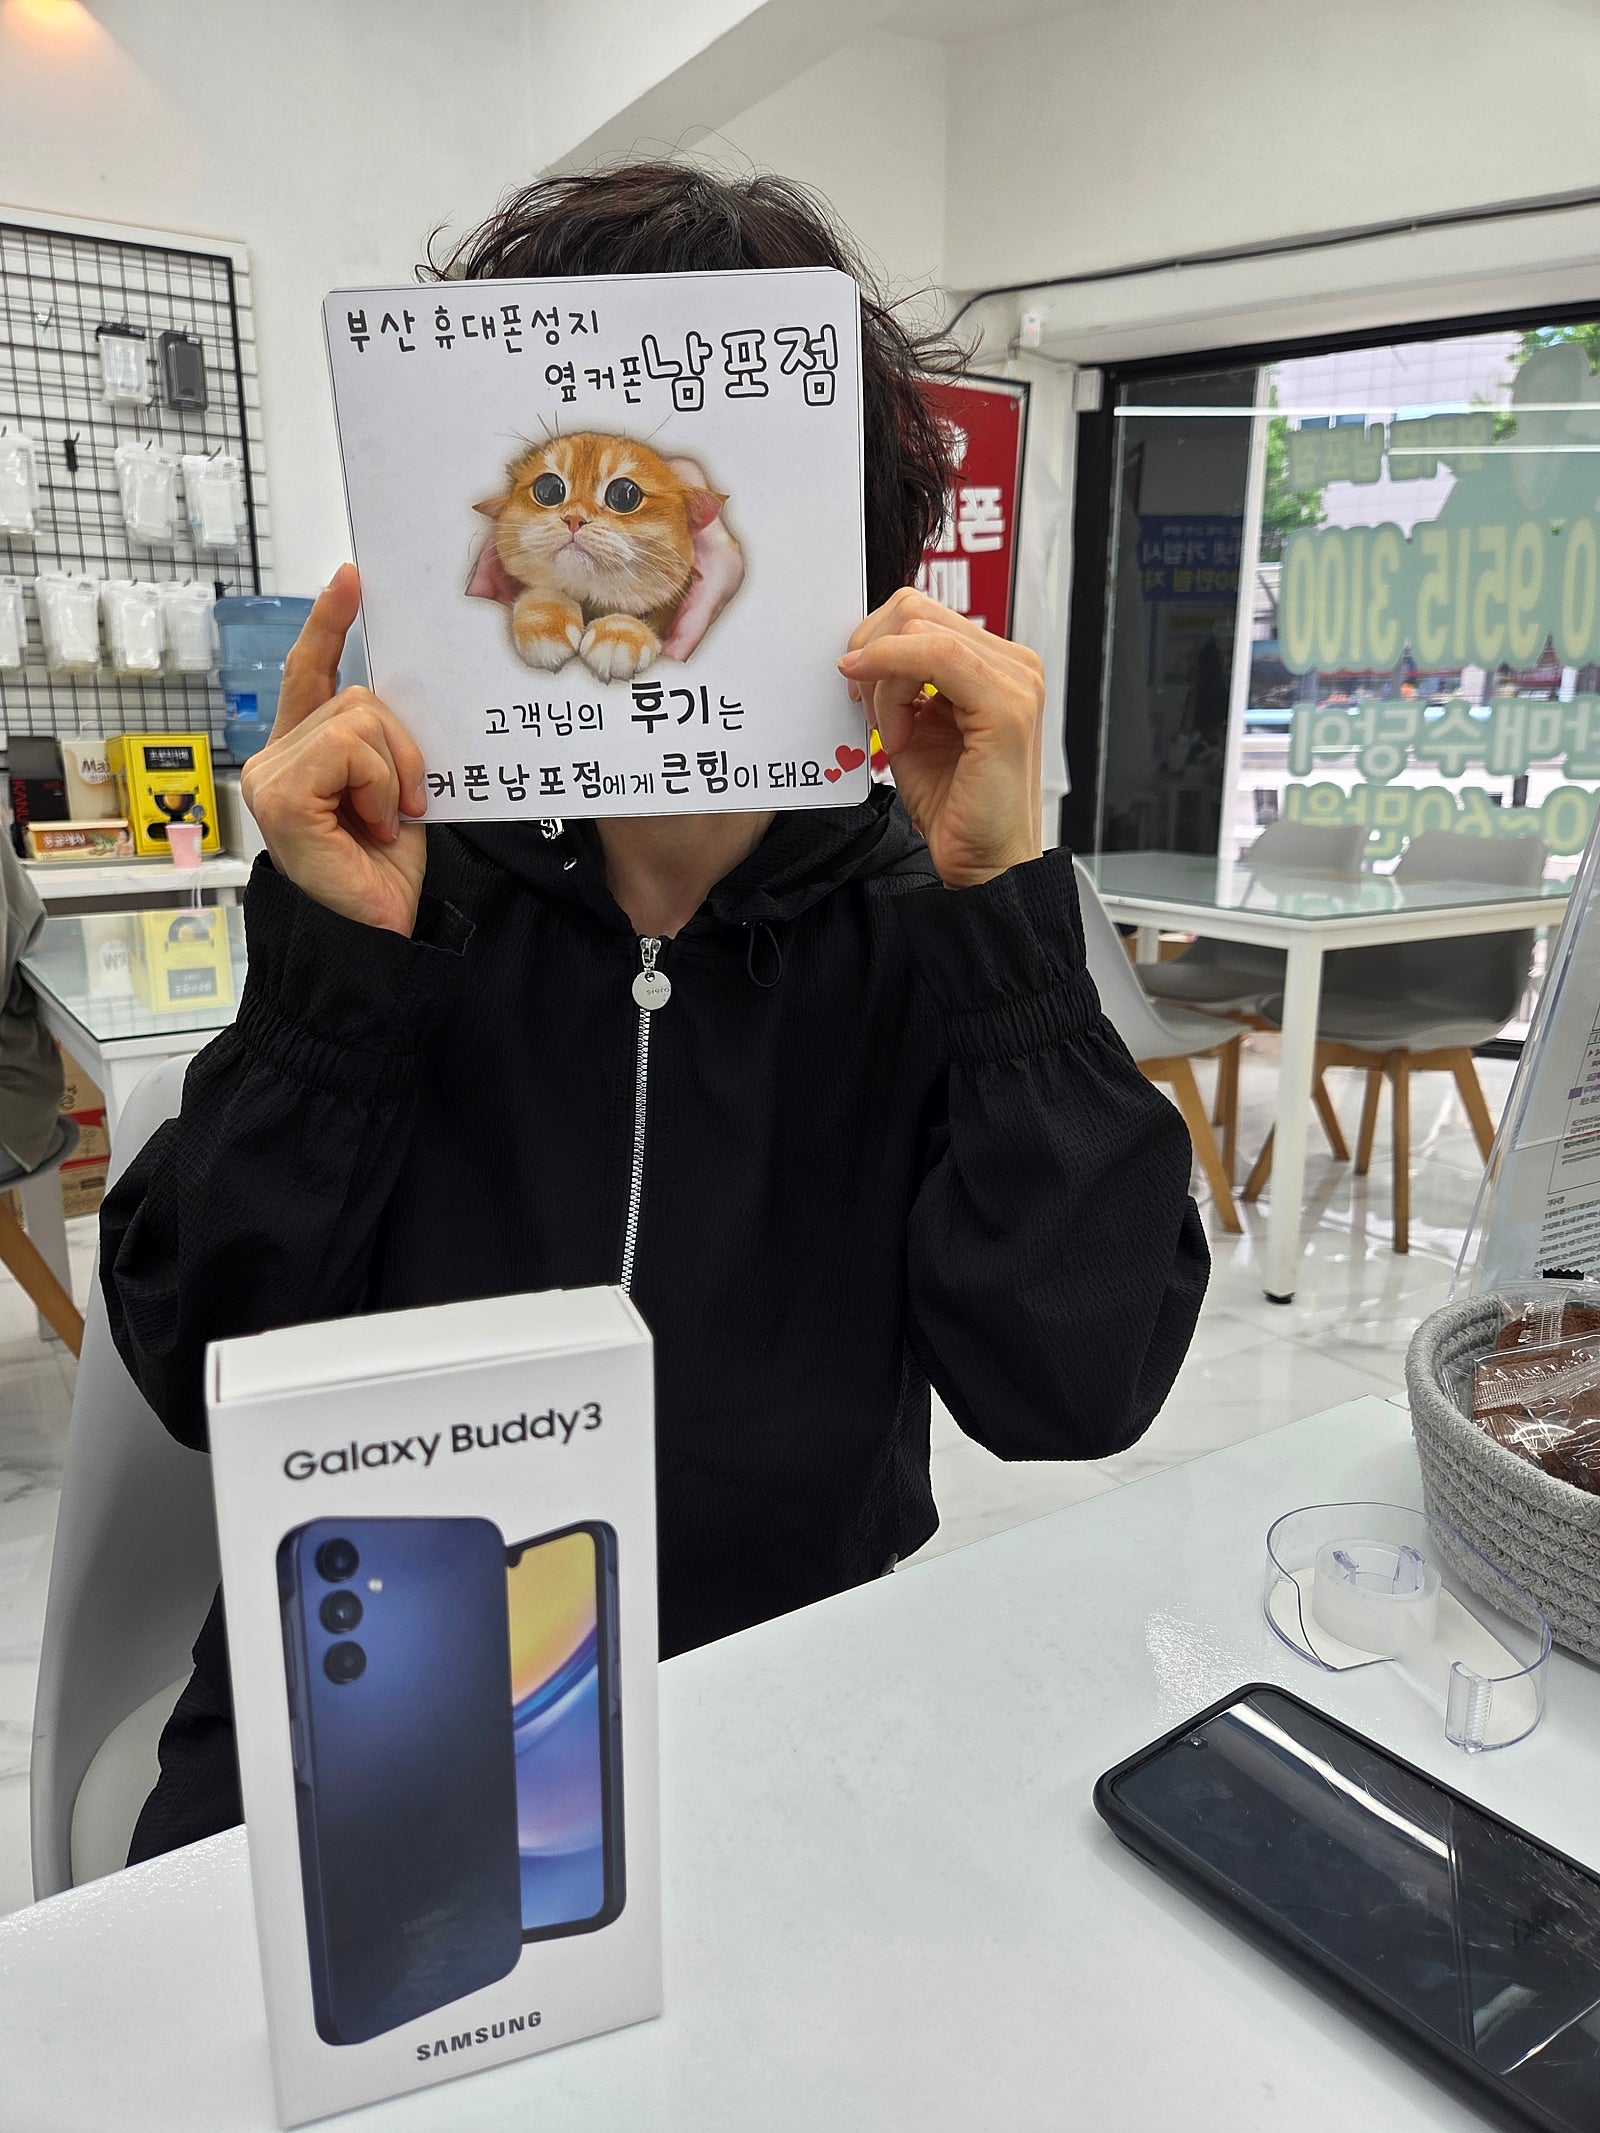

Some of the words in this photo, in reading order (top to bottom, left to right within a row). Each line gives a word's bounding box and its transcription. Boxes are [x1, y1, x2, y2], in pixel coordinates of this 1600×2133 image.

[347, 309, 417, 354] 부산
[433, 304, 600, 355] 휴대폰성지
[485, 700, 604, 738] 고객님의
[630, 680, 745, 735] 후기는
[426, 760, 655, 803] 커폰남포점에게
[282, 1433, 442, 1482] Galaxy
[451, 1402, 603, 1454] Buddy3
[416, 2011, 541, 2061] SAMSUNG
